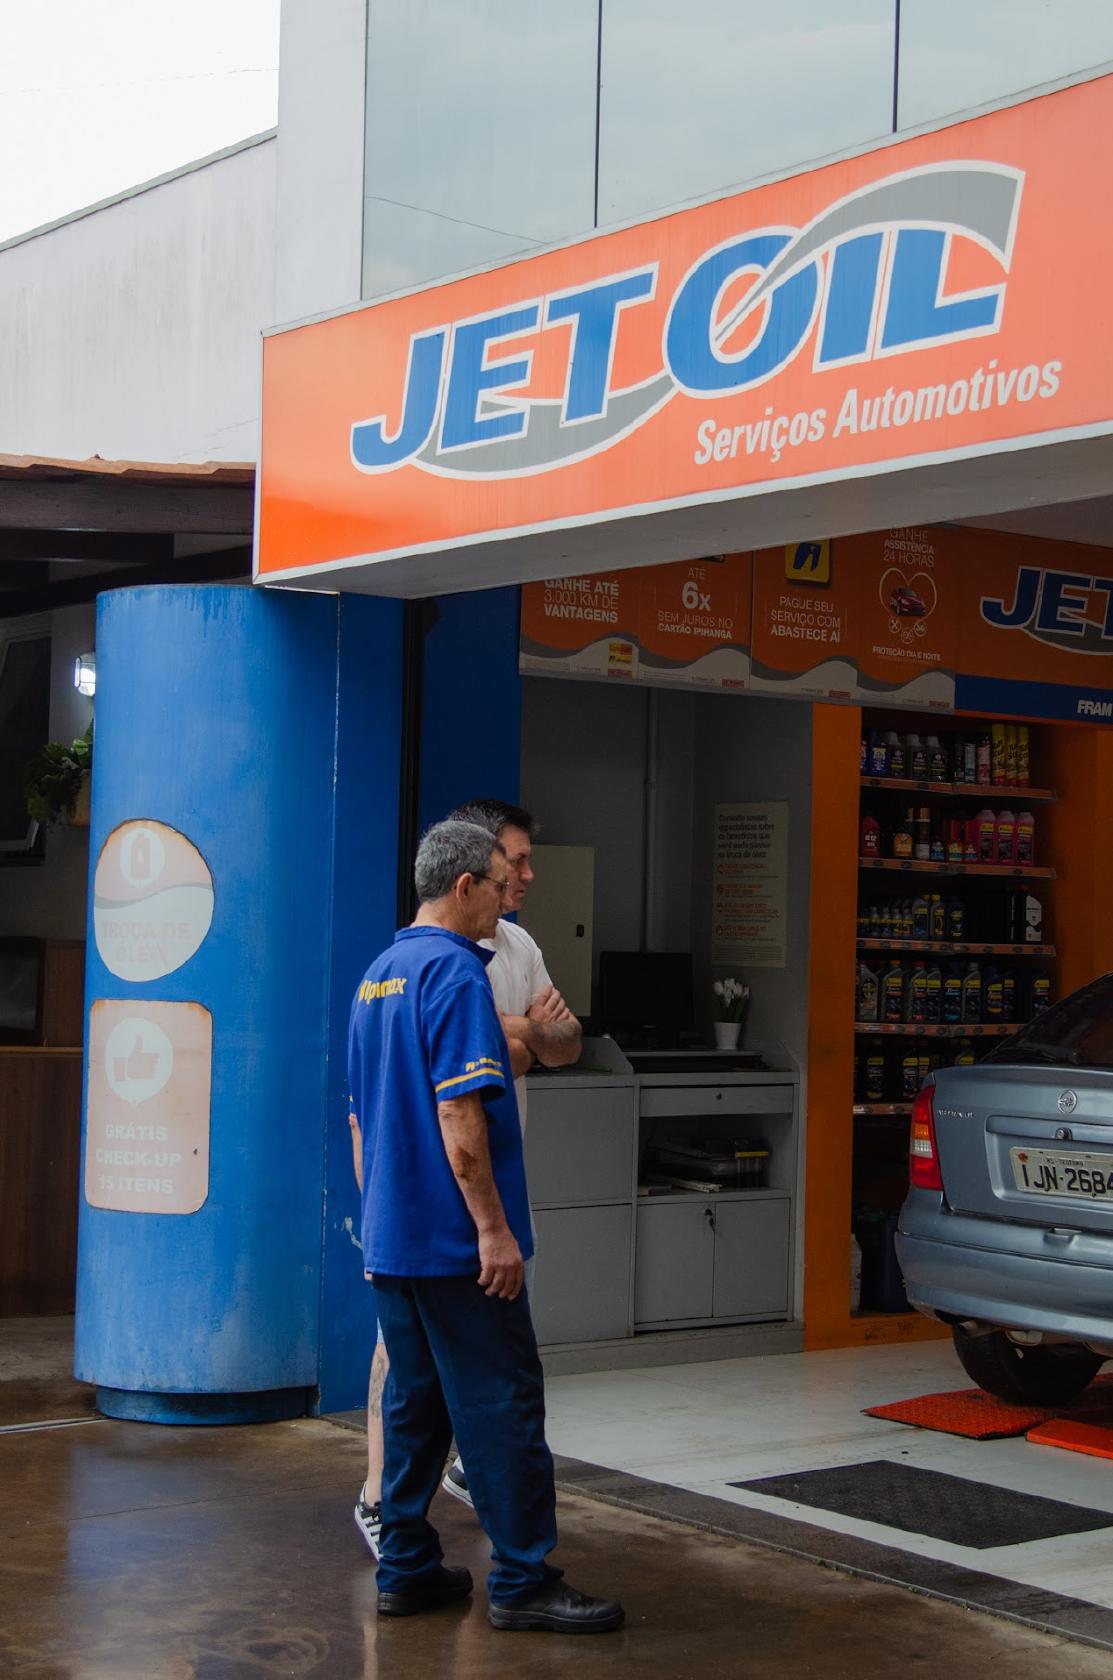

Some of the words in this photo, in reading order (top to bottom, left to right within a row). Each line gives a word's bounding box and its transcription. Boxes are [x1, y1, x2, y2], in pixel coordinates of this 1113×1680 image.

[693, 406, 826, 465] Serviços
[833, 359, 1062, 439] Automotivos
[889, 527, 929, 543] GANHE
[883, 550, 896, 561] 24
[898, 551, 936, 568] HORAS
[544, 578, 591, 593] GANHE
[593, 580, 620, 596] ATÉ
[543, 588, 577, 605] 3.000
[579, 592, 598, 608] KM
[602, 595, 619, 610] DE
[779, 595, 814, 611] PAGUE
[814, 600, 834, 613] SEU
[543, 603, 619, 624] VANTAGENS
[657, 610, 680, 623] SEM
[682, 613, 716, 628] JUROS
[718, 617, 734, 630] NO
[770, 610, 816, 627] SERVIÇO
[816, 615, 841, 629] COM
[693, 627, 733, 640] IPIRANGA
[770, 626, 828, 642] ABASTECE
[1076, 699, 1113, 717] FRAM
[95, 1148, 183, 1167] CHECK-UP
[118, 1176, 174, 1195] ITENS
